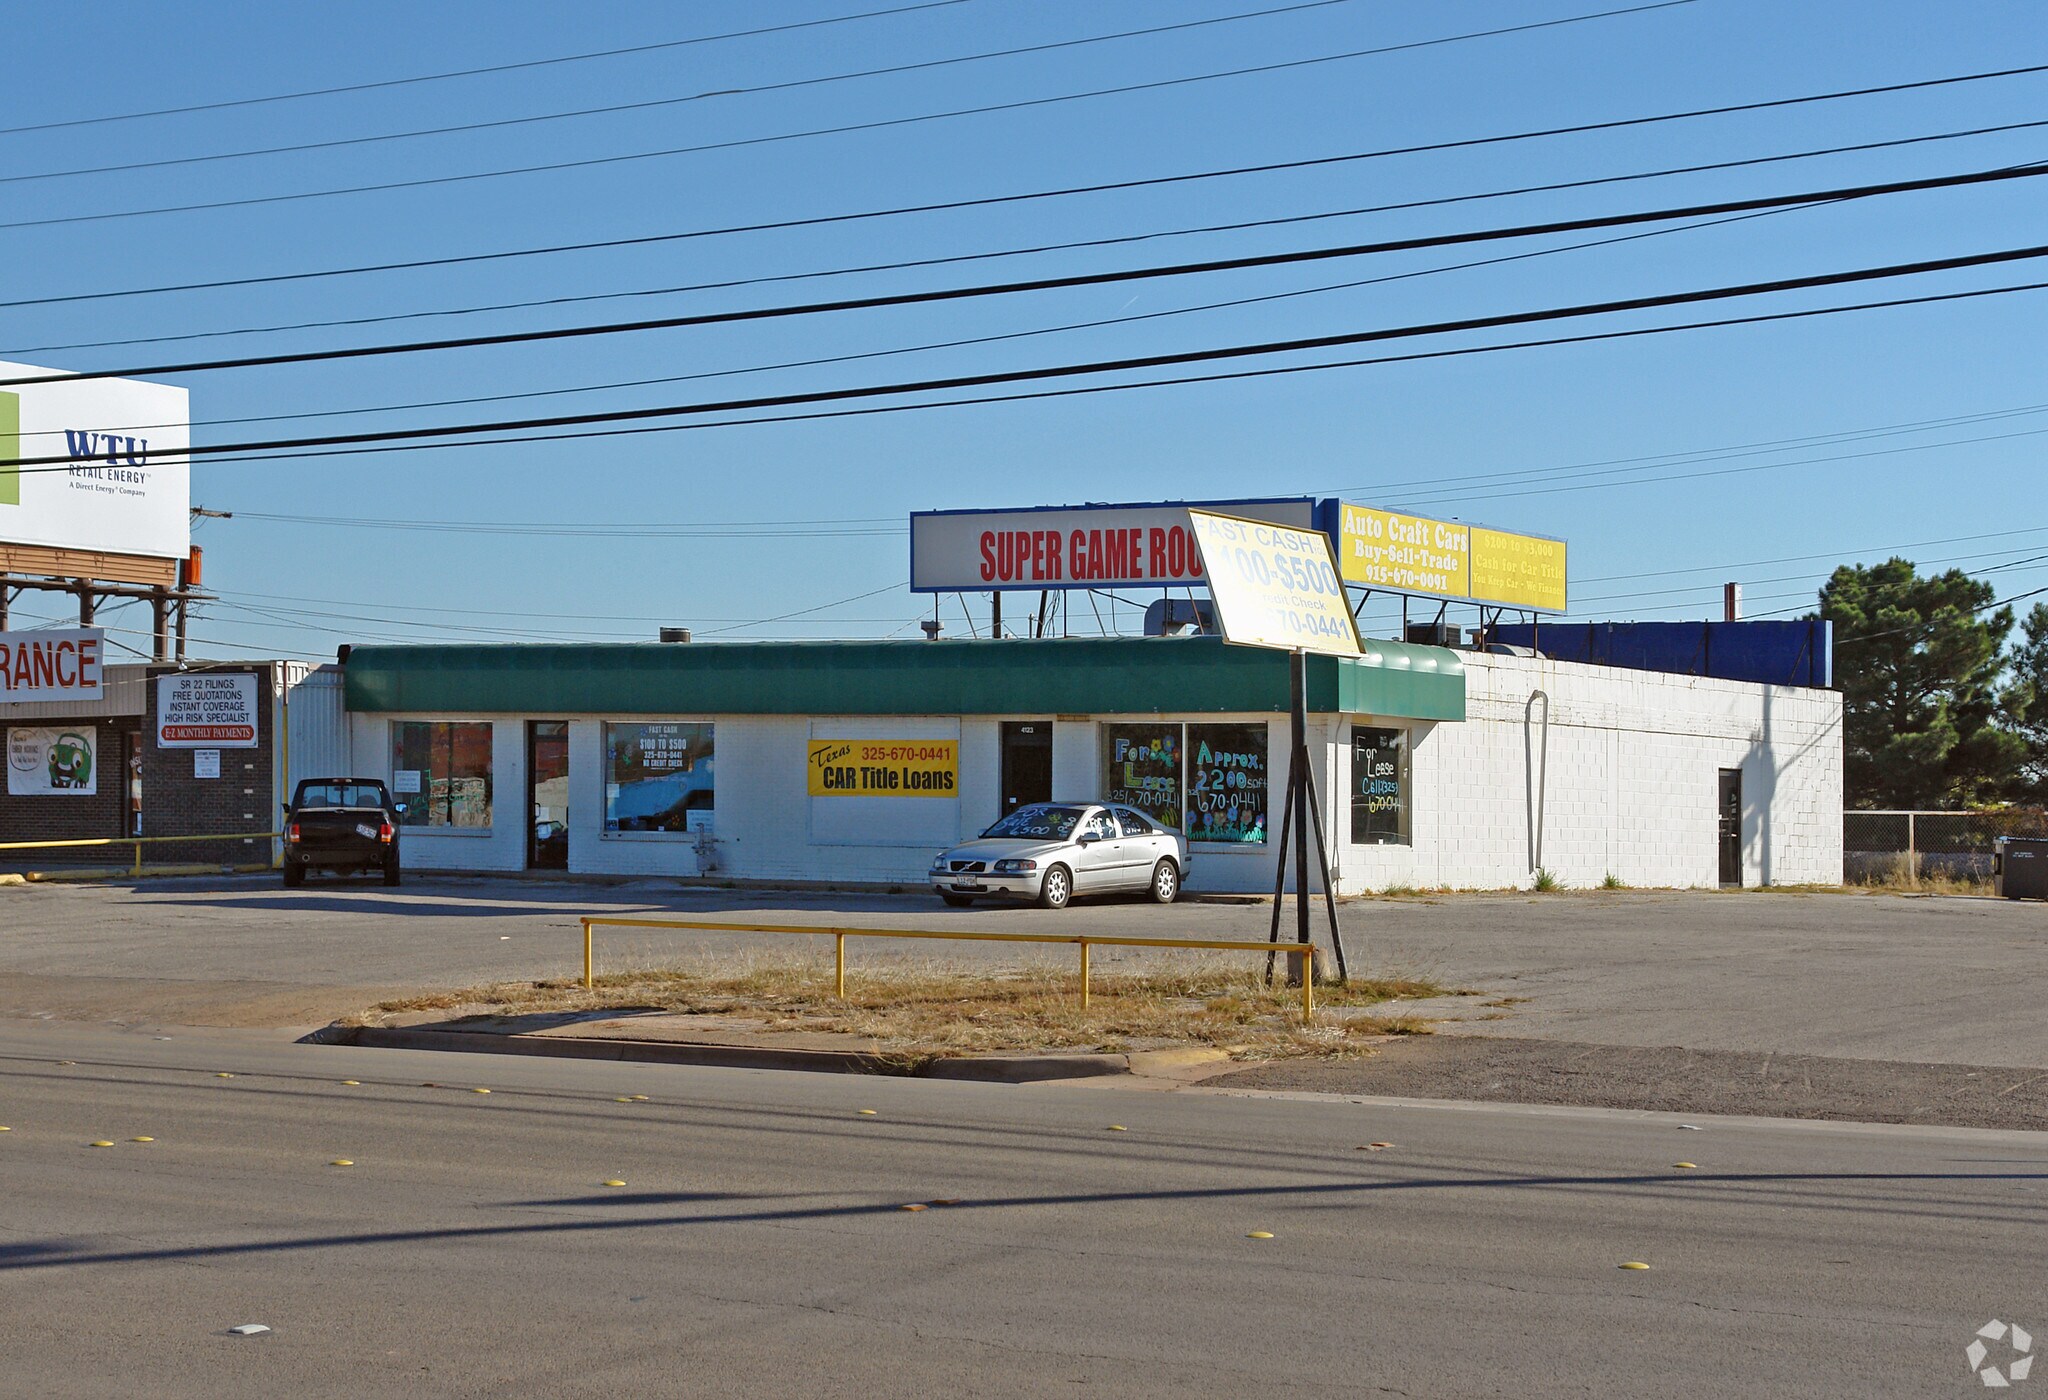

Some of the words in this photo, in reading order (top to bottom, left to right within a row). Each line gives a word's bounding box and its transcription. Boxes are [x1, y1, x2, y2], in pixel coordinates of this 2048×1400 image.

[65, 429, 148, 467] WTU
[69, 464, 103, 479] RETAIL
[75, 482, 94, 491] Direct
[119, 487, 146, 497] Company
[1255, 527, 1314, 554] CASH
[1344, 508, 1383, 539] Auto
[1388, 516, 1429, 546] Craft
[1435, 523, 1467, 553] Cars
[979, 530, 1062, 582] SUPER
[1069, 527, 1143, 581] GAME
[1149, 525, 1203, 578] ROO
[1354, 538, 1458, 572] Buy-Sell-Trade
[1511, 539, 1520, 552] to
[1204, 543, 1339, 597] 100-$500
[1476, 553, 1499, 570] Cash
[1503, 558, 1518, 573] for
[1521, 560, 1538, 576] Car
[1366, 564, 1448, 591] 915-670-0091
[1507, 578, 1519, 589] Car
[1291, 596, 1327, 611] Check
[180, 680, 191, 689] SR
[193, 680, 203, 689] 22
[205, 680, 235, 689] FILINGS
[173, 690, 192, 700] FREE
[195, 690, 243, 701] QUOTATIONS
[165, 713, 184, 722] HIGH
[186, 713, 204, 722] RISK
[206, 713, 250, 722] SPECIALIST
[170, 702, 201, 712] INSTANT
[203, 702, 245, 712] COVERAGE
[165, 728, 176, 738] E-Z
[177, 727, 212, 738] MONTHLY
[213, 727, 251, 738] PAYMENTS
[649, 726, 662, 734] FAST
[663, 726, 678, 734] CASH
[640, 739, 656, 750] $100
[657, 739, 667, 750] TO
[669, 739, 687, 750] $500
[1115, 738, 1150, 762] For
[1356, 735, 1378, 762] For
[651, 759, 667, 767] CREDIT
[668, 759, 683, 767] CHECK
[810, 744, 851, 767] Texas
[861, 747, 951, 761] 325-670-0441
[823, 766, 856, 789] CAR
[860, 766, 899, 789] Title
[902, 767, 954, 790] Loans
[1124, 761, 1176, 792] Lease
[1367, 758, 1395, 778] Lease
[1195, 769, 1247, 791] 2200
